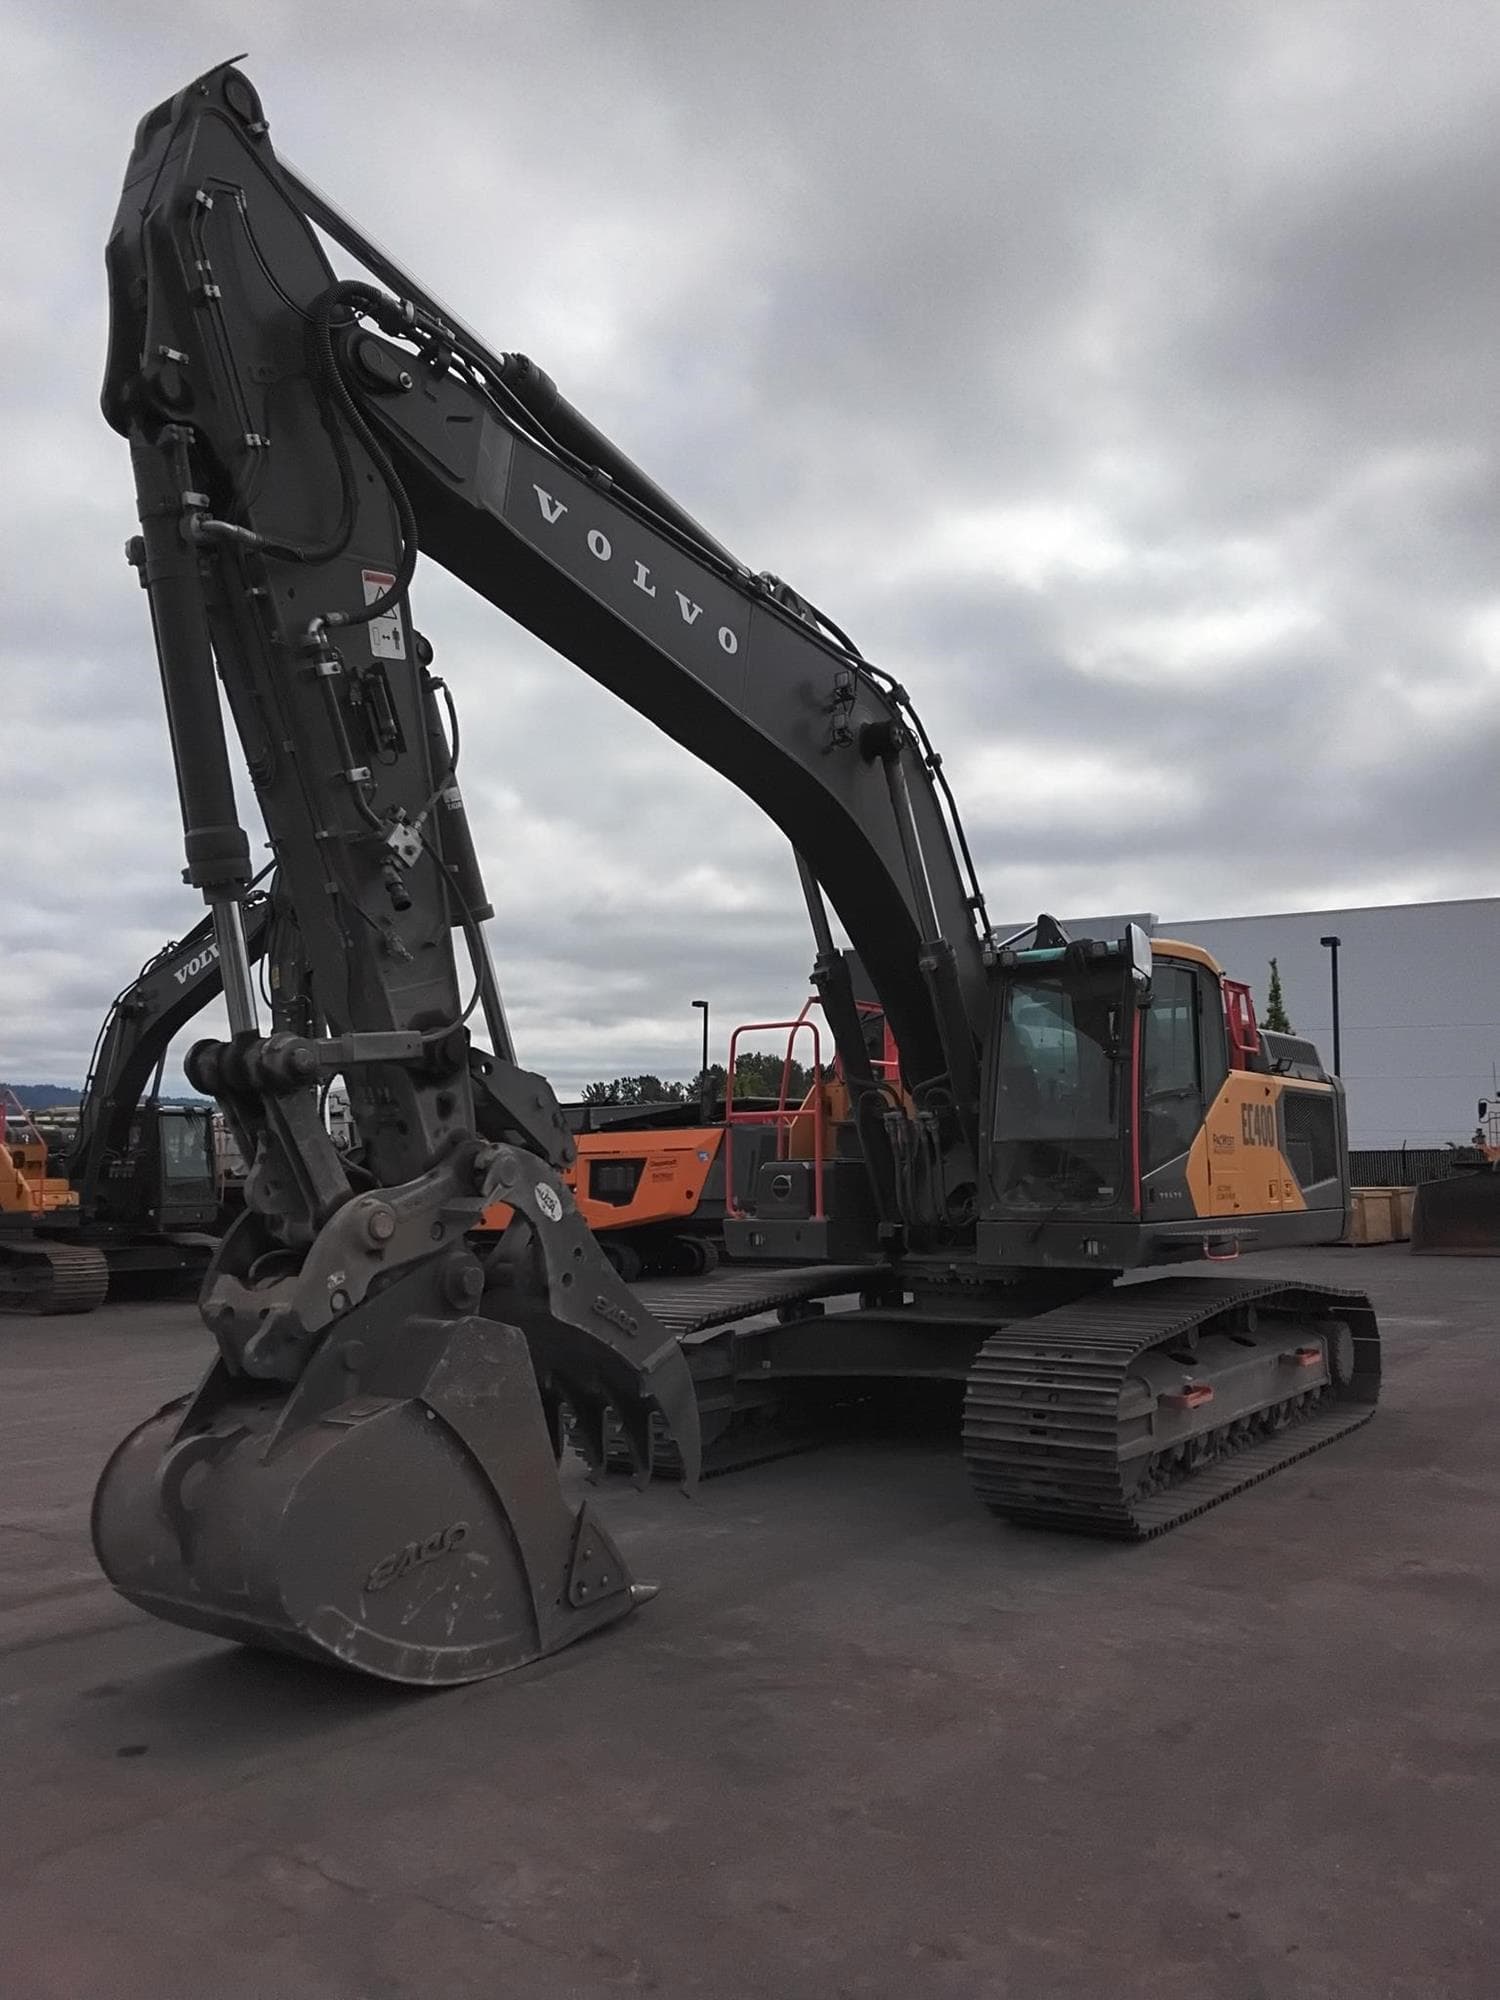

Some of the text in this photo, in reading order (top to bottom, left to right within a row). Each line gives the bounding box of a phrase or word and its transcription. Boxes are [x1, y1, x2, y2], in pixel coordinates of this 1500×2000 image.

[533, 484, 738, 654] VOLVO
[174, 943, 220, 984] VOLV
[1241, 1103, 1275, 1147] EC400
